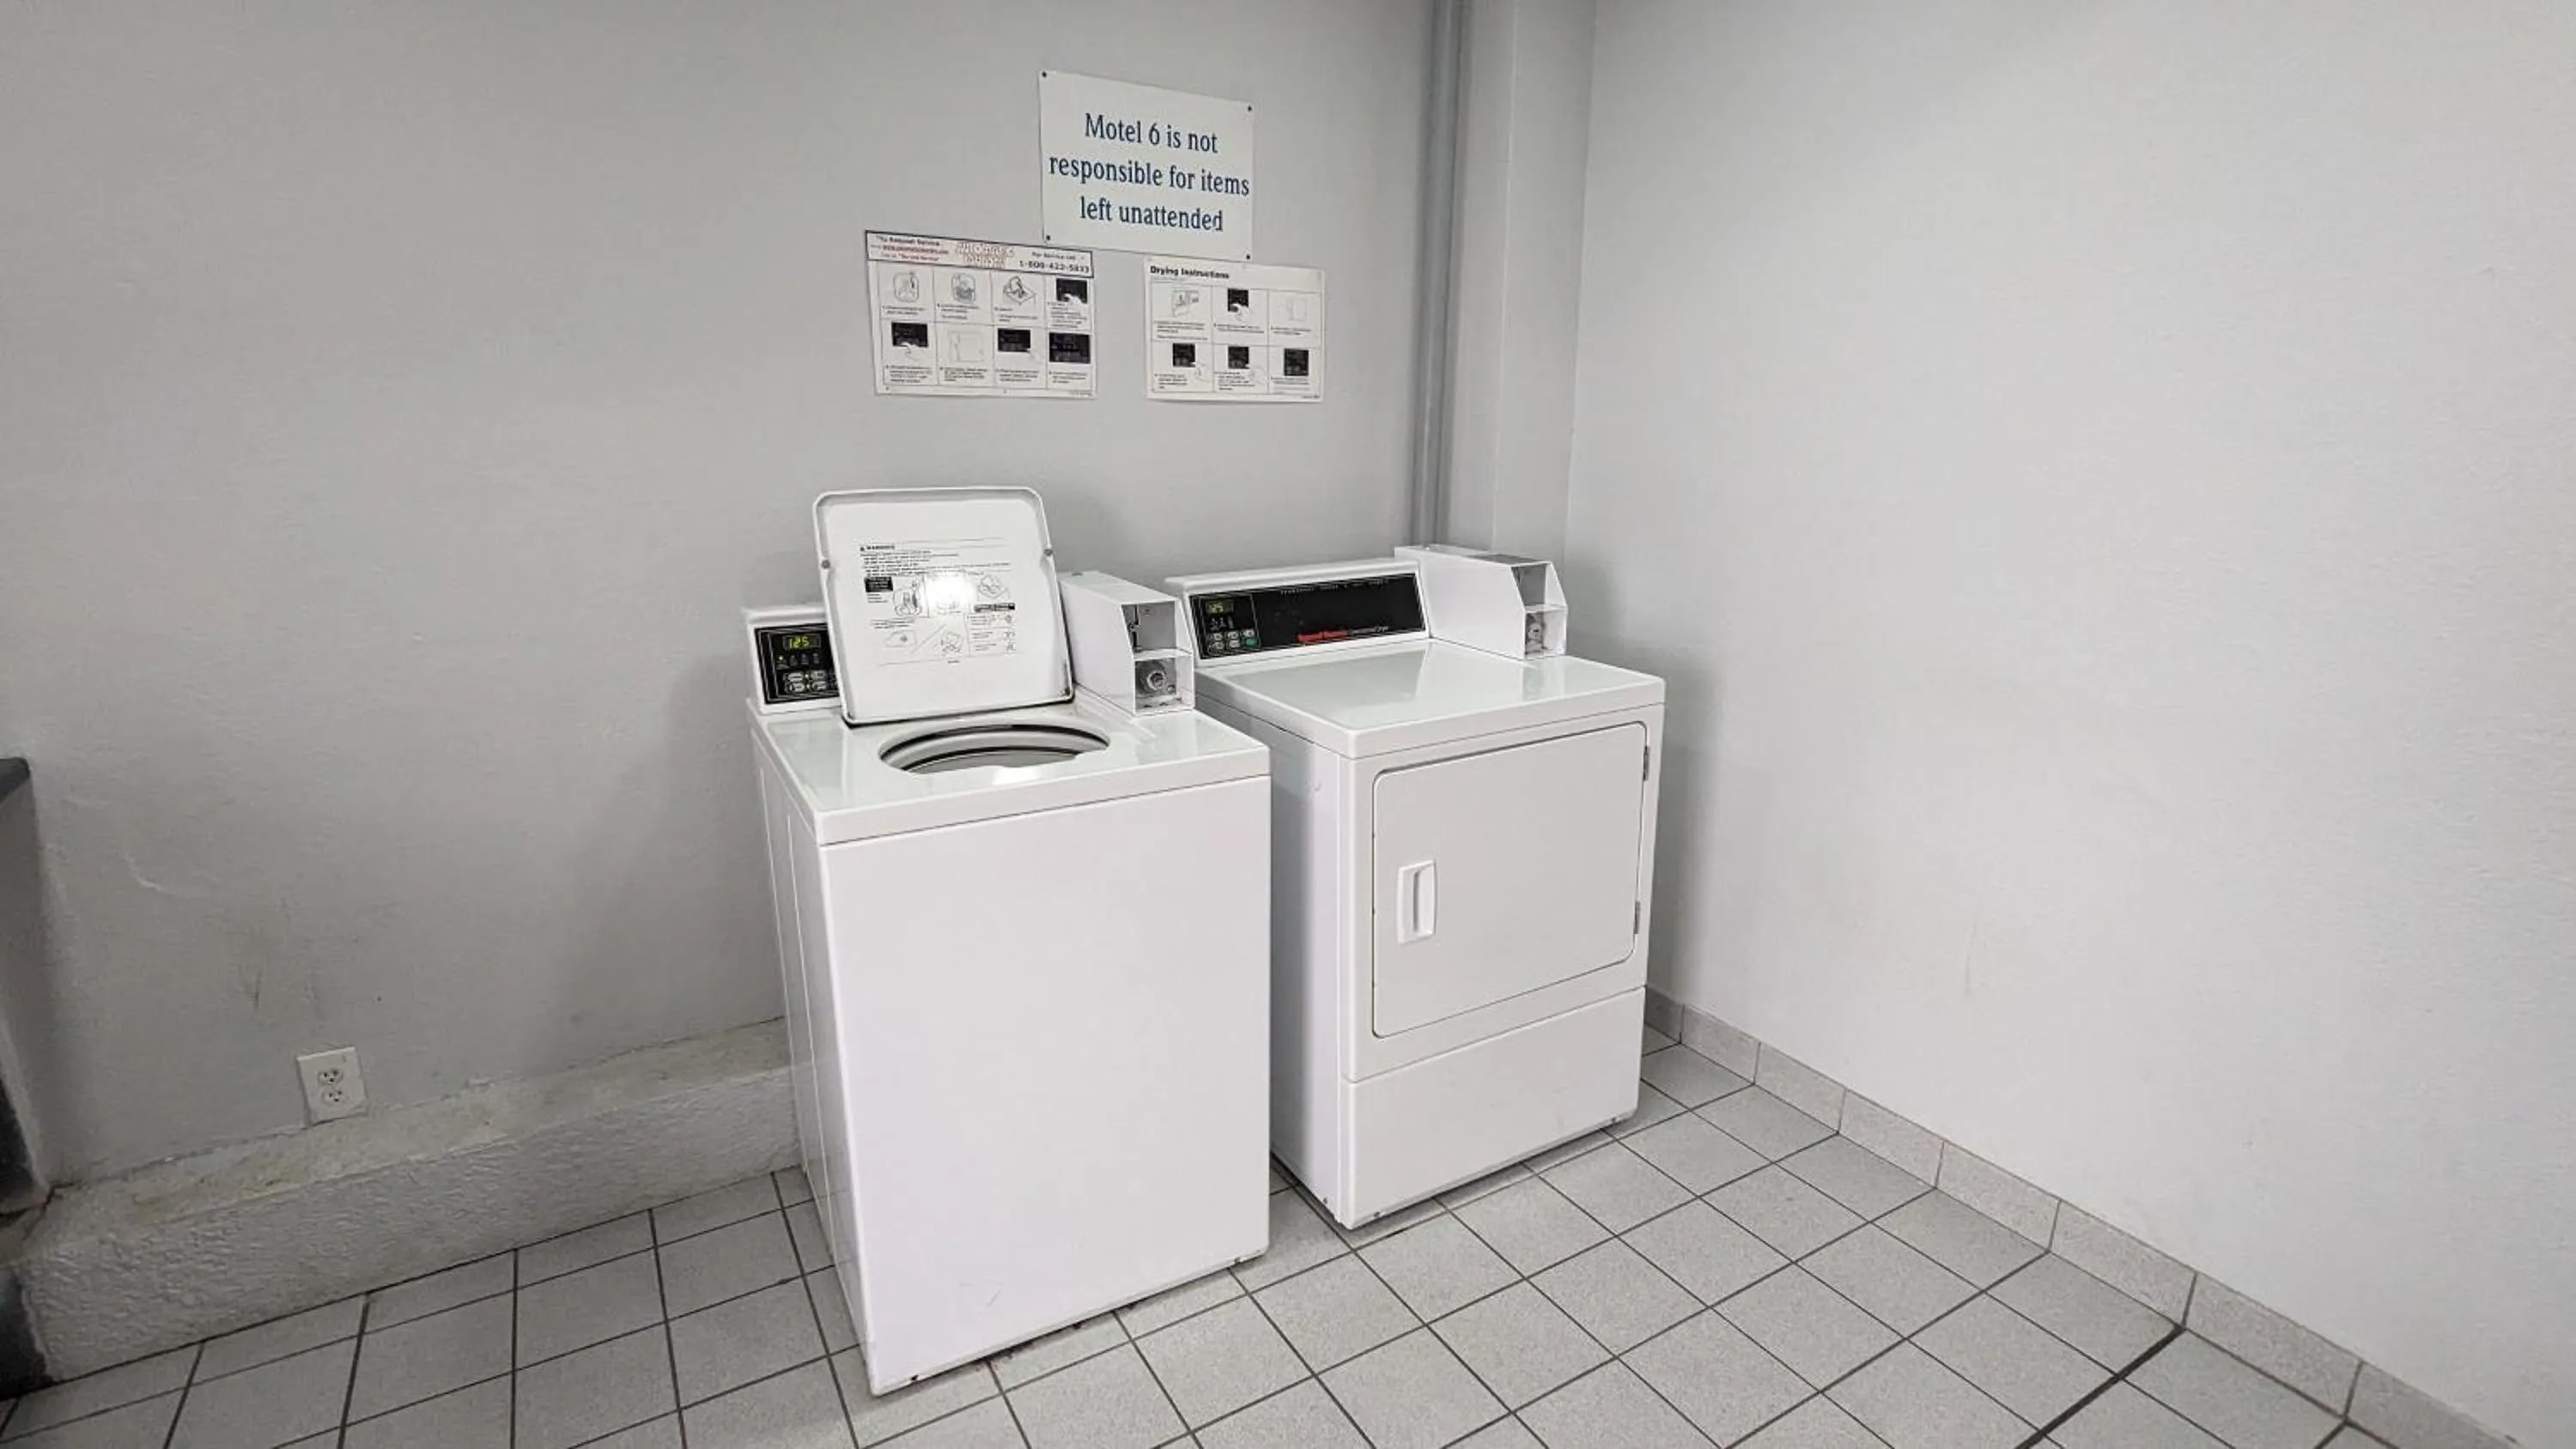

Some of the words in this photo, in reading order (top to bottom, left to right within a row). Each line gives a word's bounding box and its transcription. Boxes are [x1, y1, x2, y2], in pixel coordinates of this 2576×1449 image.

[1084, 113, 1141, 142] Motel
[1148, 123, 1160, 145] 6
[1167, 124, 1181, 148] is
[1188, 133, 1218, 153] not
[1049, 156, 1163, 186] responsible
[1169, 165, 1195, 189] for
[1201, 169, 1250, 196] items
[1080, 196, 1113, 221] left
[1120, 205, 1223, 231] unattended
[1151, 265, 1178, 276] Drying
[1181, 268, 1230, 279] Instructions
